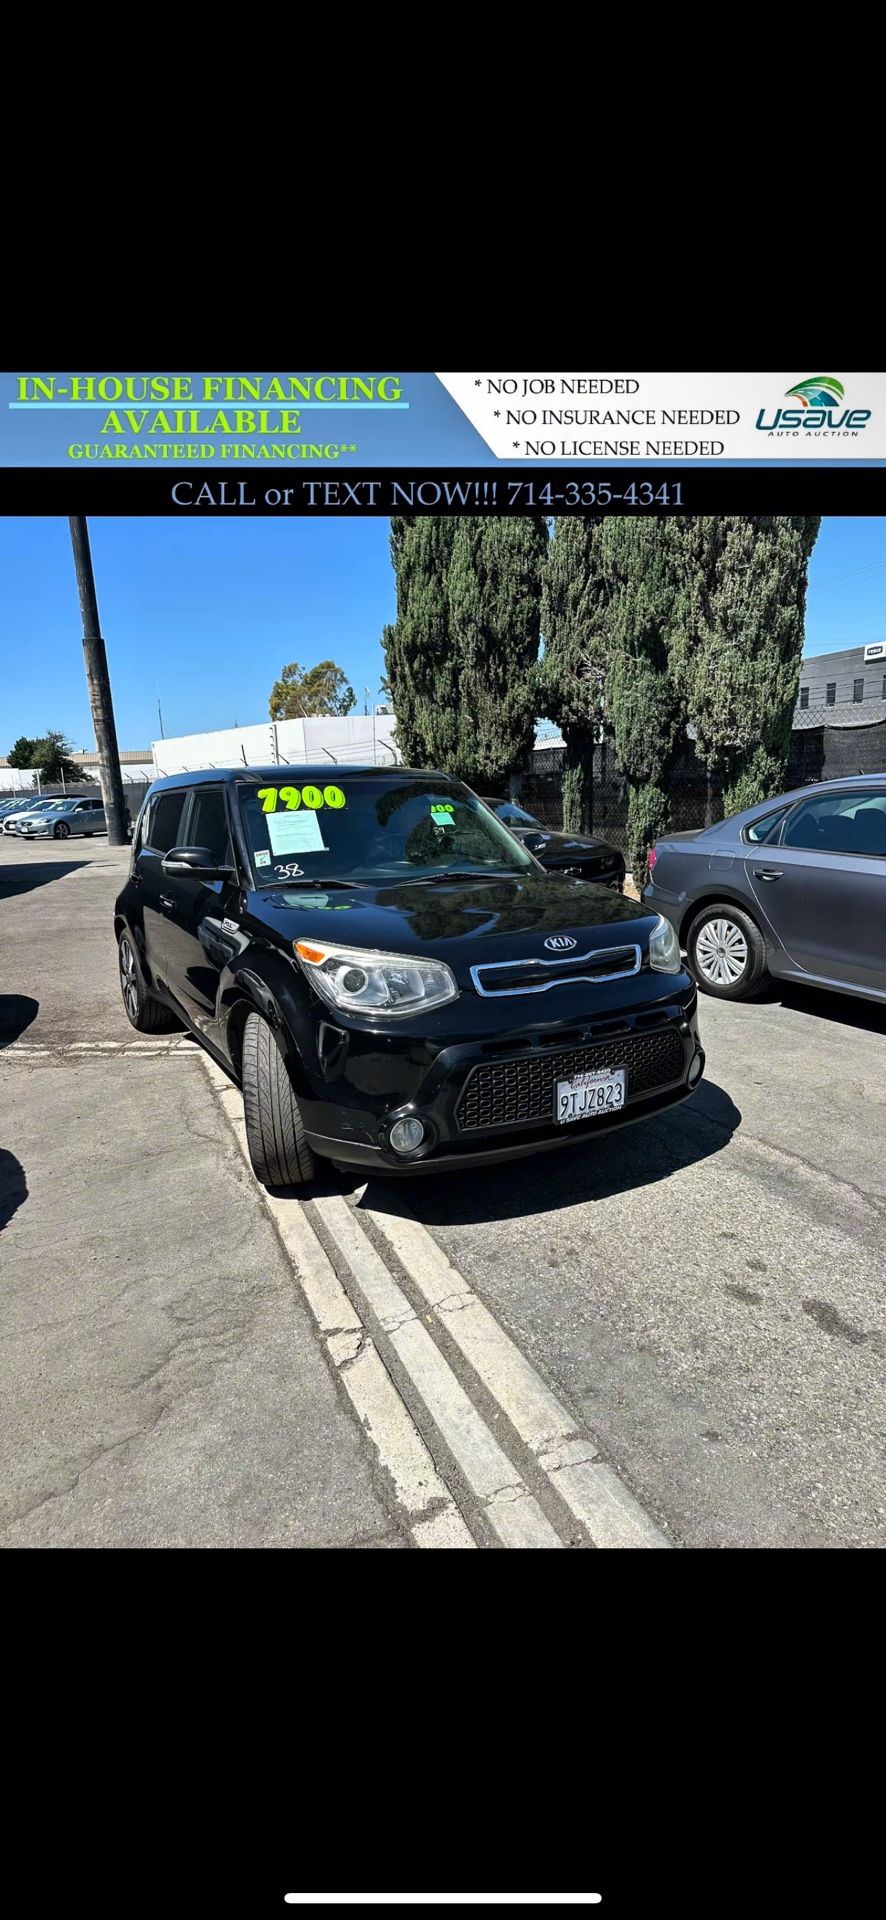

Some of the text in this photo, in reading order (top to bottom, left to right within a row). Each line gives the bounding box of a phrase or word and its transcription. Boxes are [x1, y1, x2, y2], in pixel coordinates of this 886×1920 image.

[257, 785, 347, 814] 7900
[273, 862, 305, 880] 38
[550, 937, 573, 948] KIA
[560, 1083, 622, 1117] 9TJZ823
